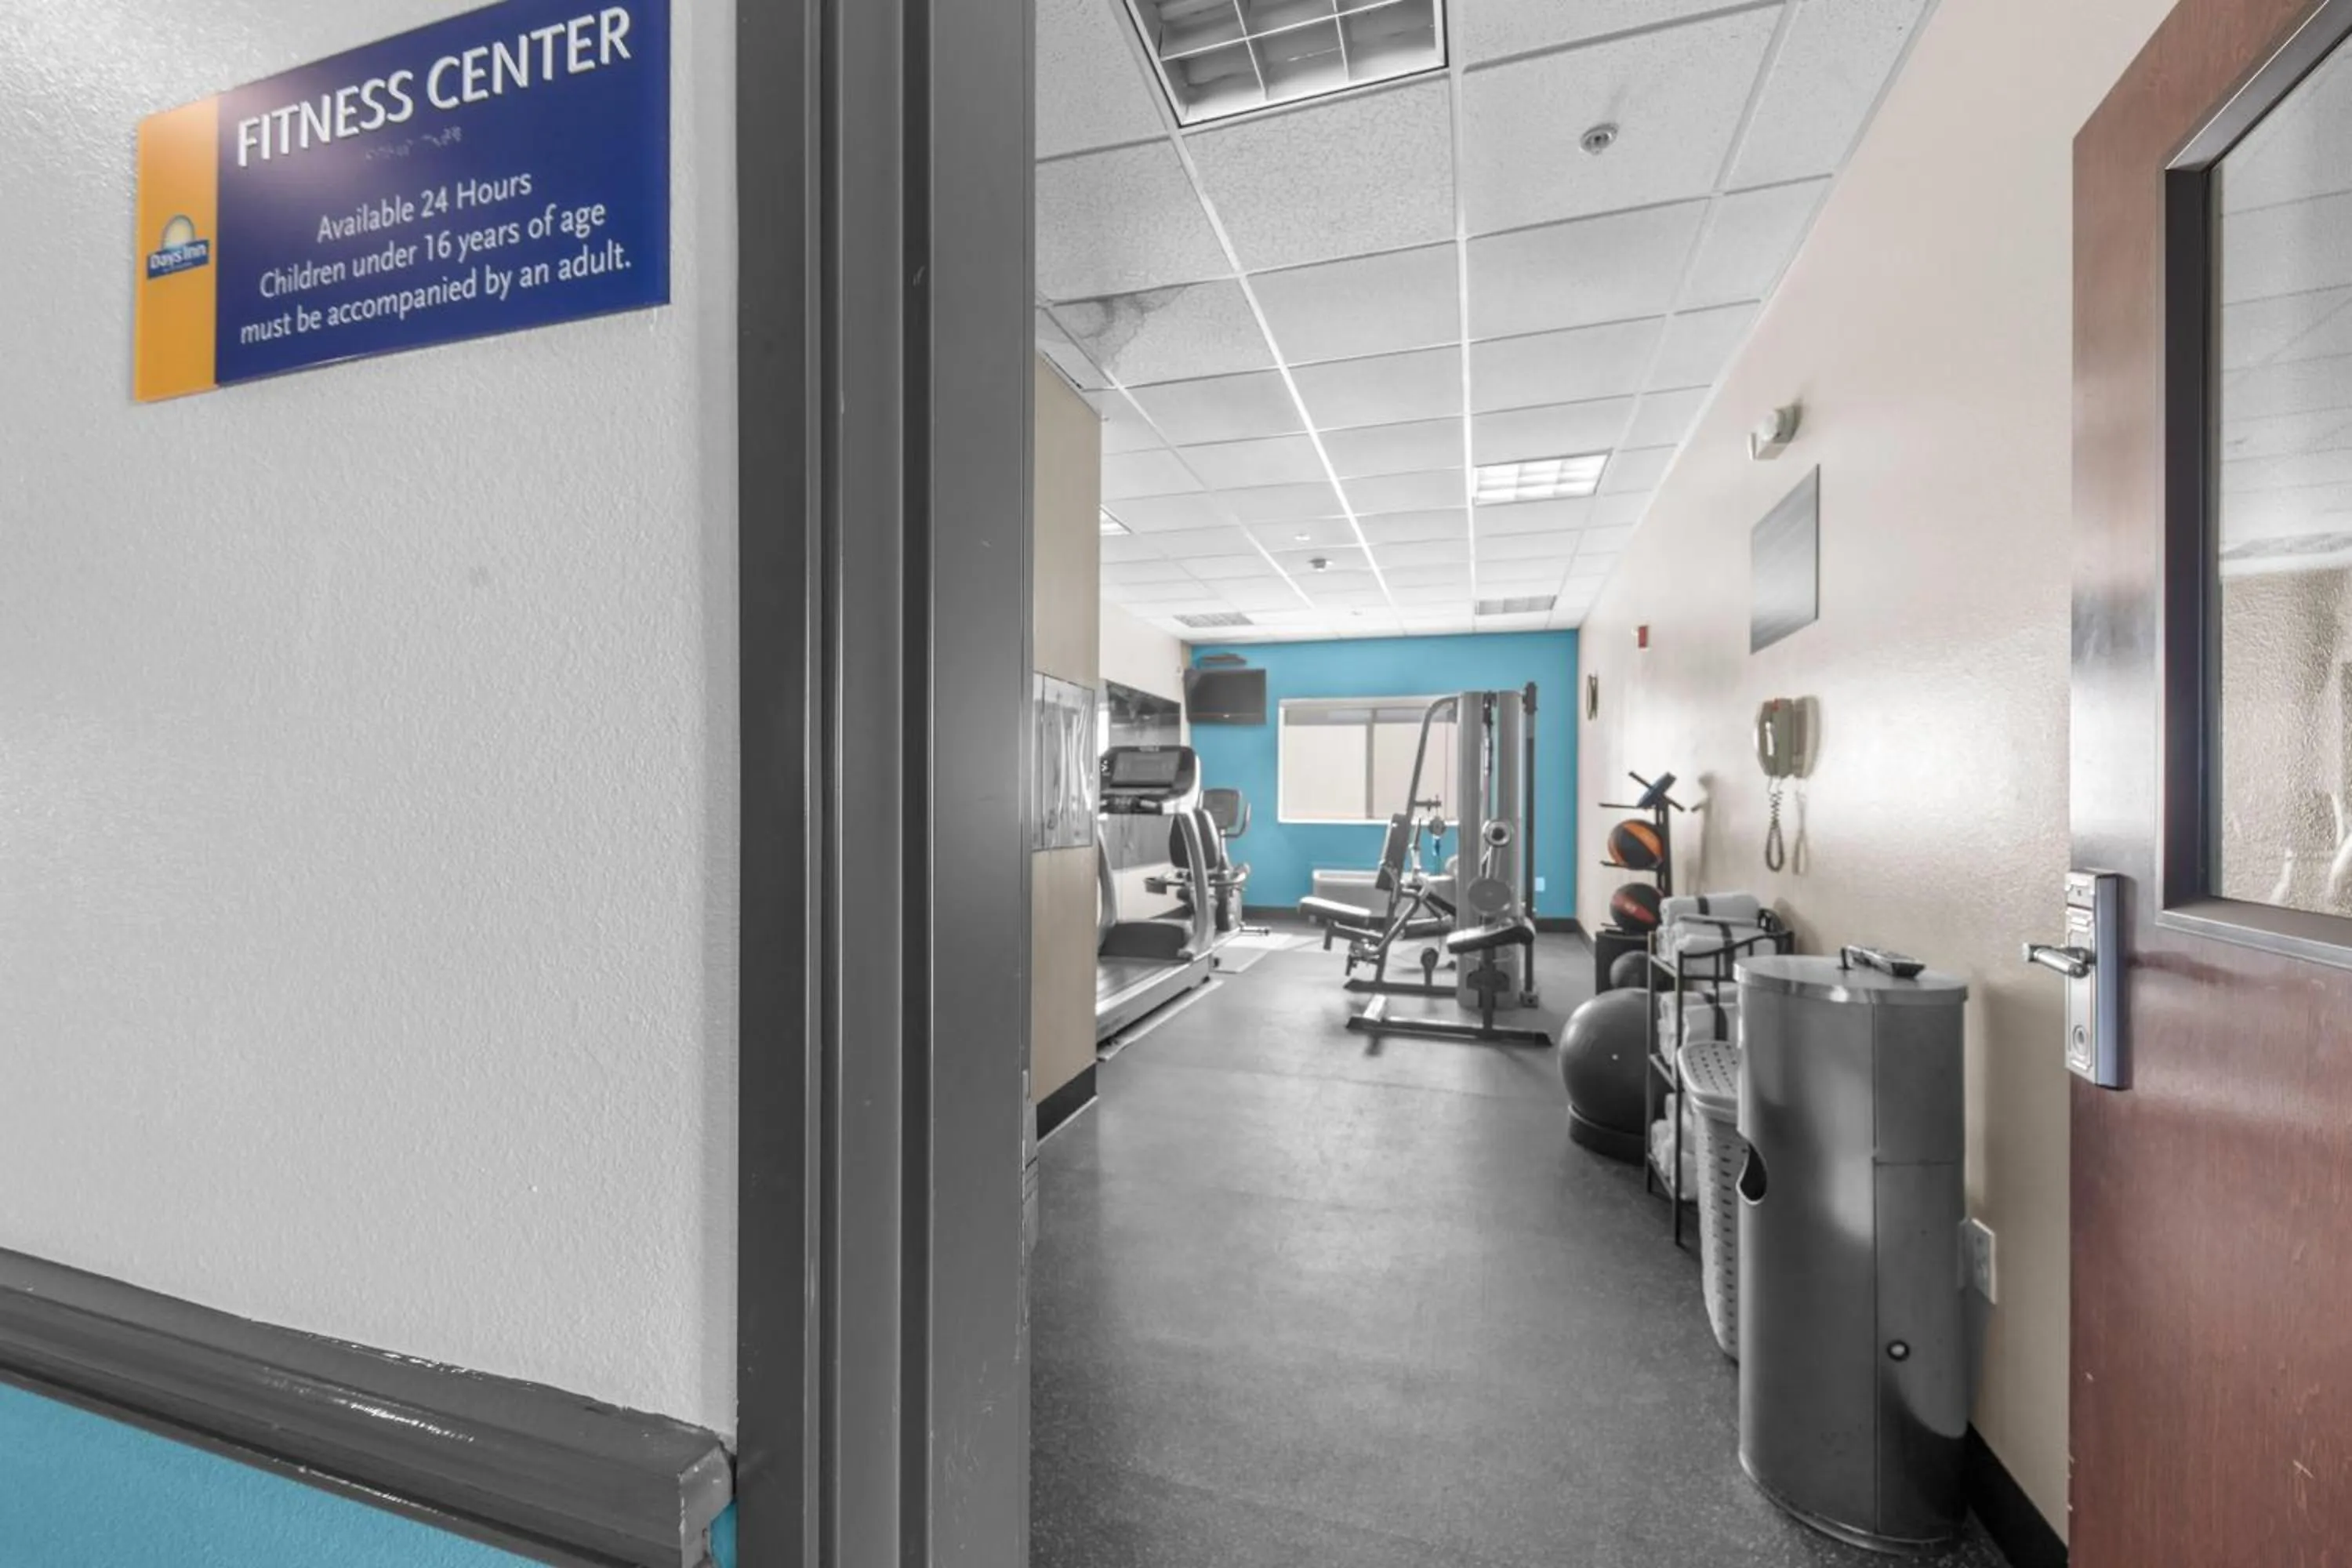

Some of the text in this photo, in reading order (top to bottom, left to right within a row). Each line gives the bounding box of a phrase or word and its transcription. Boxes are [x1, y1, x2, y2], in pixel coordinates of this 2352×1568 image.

[238, 6, 631, 167] FITNESS CENTER
[260, 203, 606, 298] Children under 16 years of age
[317, 173, 532, 243] Available 24 Hours
[150, 251, 181, 269] Days
[183, 244, 207, 260] Inn
[240, 238, 632, 344] must be accompanied by an adult.
